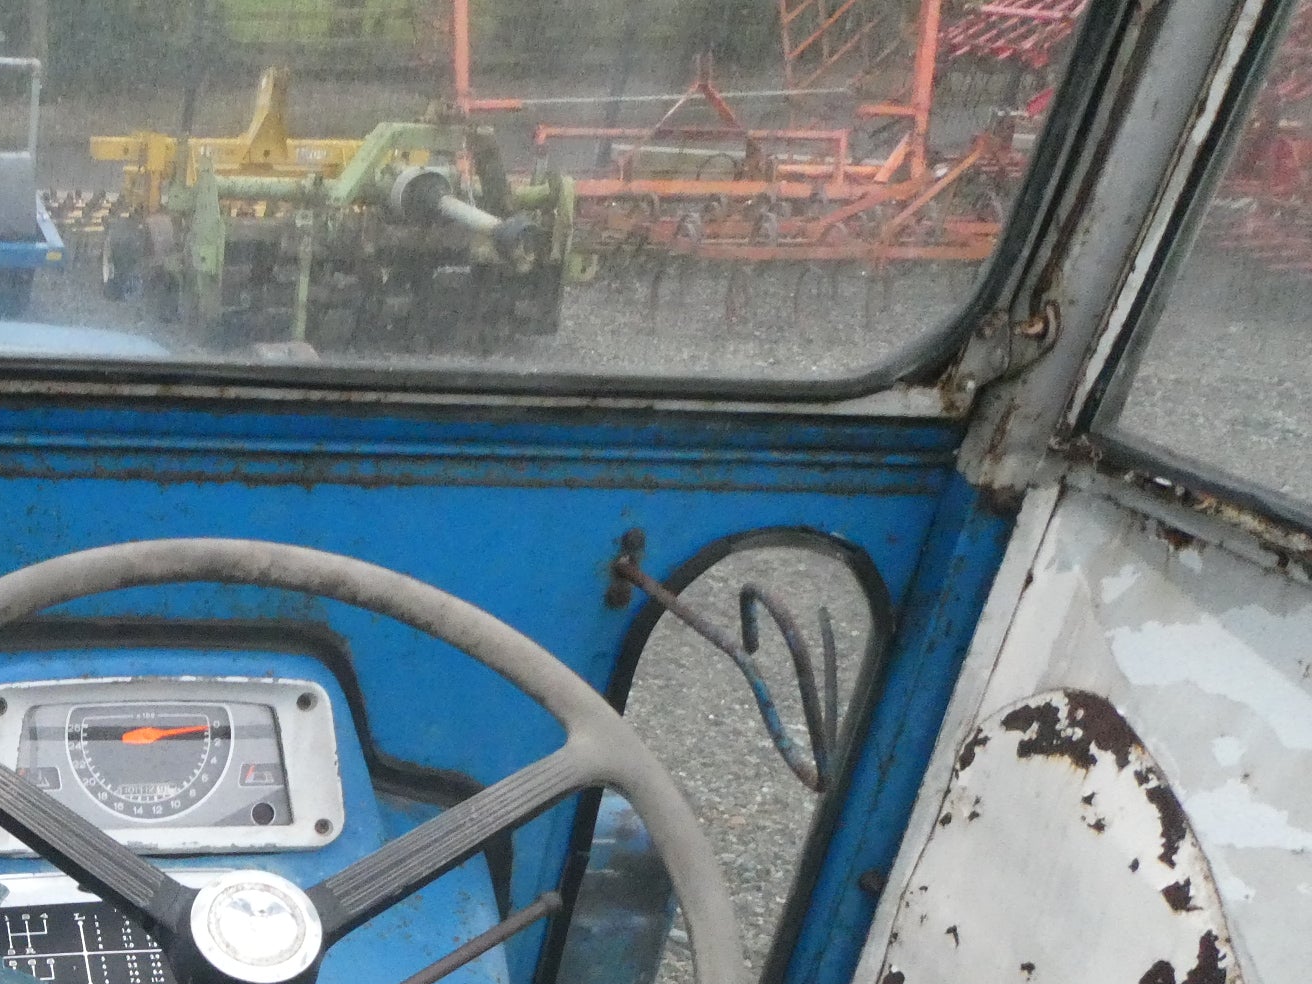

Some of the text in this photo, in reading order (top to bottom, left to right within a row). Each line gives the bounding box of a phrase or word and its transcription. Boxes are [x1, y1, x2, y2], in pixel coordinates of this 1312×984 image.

[213, 720, 220, 728] 0
[69, 741, 82, 750] 24
[214, 739, 221, 747] 2
[210, 755, 217, 764] 4
[83, 777, 96, 786] 20
[201, 773, 209, 782] 6
[97, 792, 108, 800] 18
[189, 789, 196, 797] 8
[114, 803, 124, 811] 16
[170, 800, 181, 809] 10
[133, 806, 143, 815] 14
[152, 806, 162, 815] 12
[73, 912, 86, 920] L
